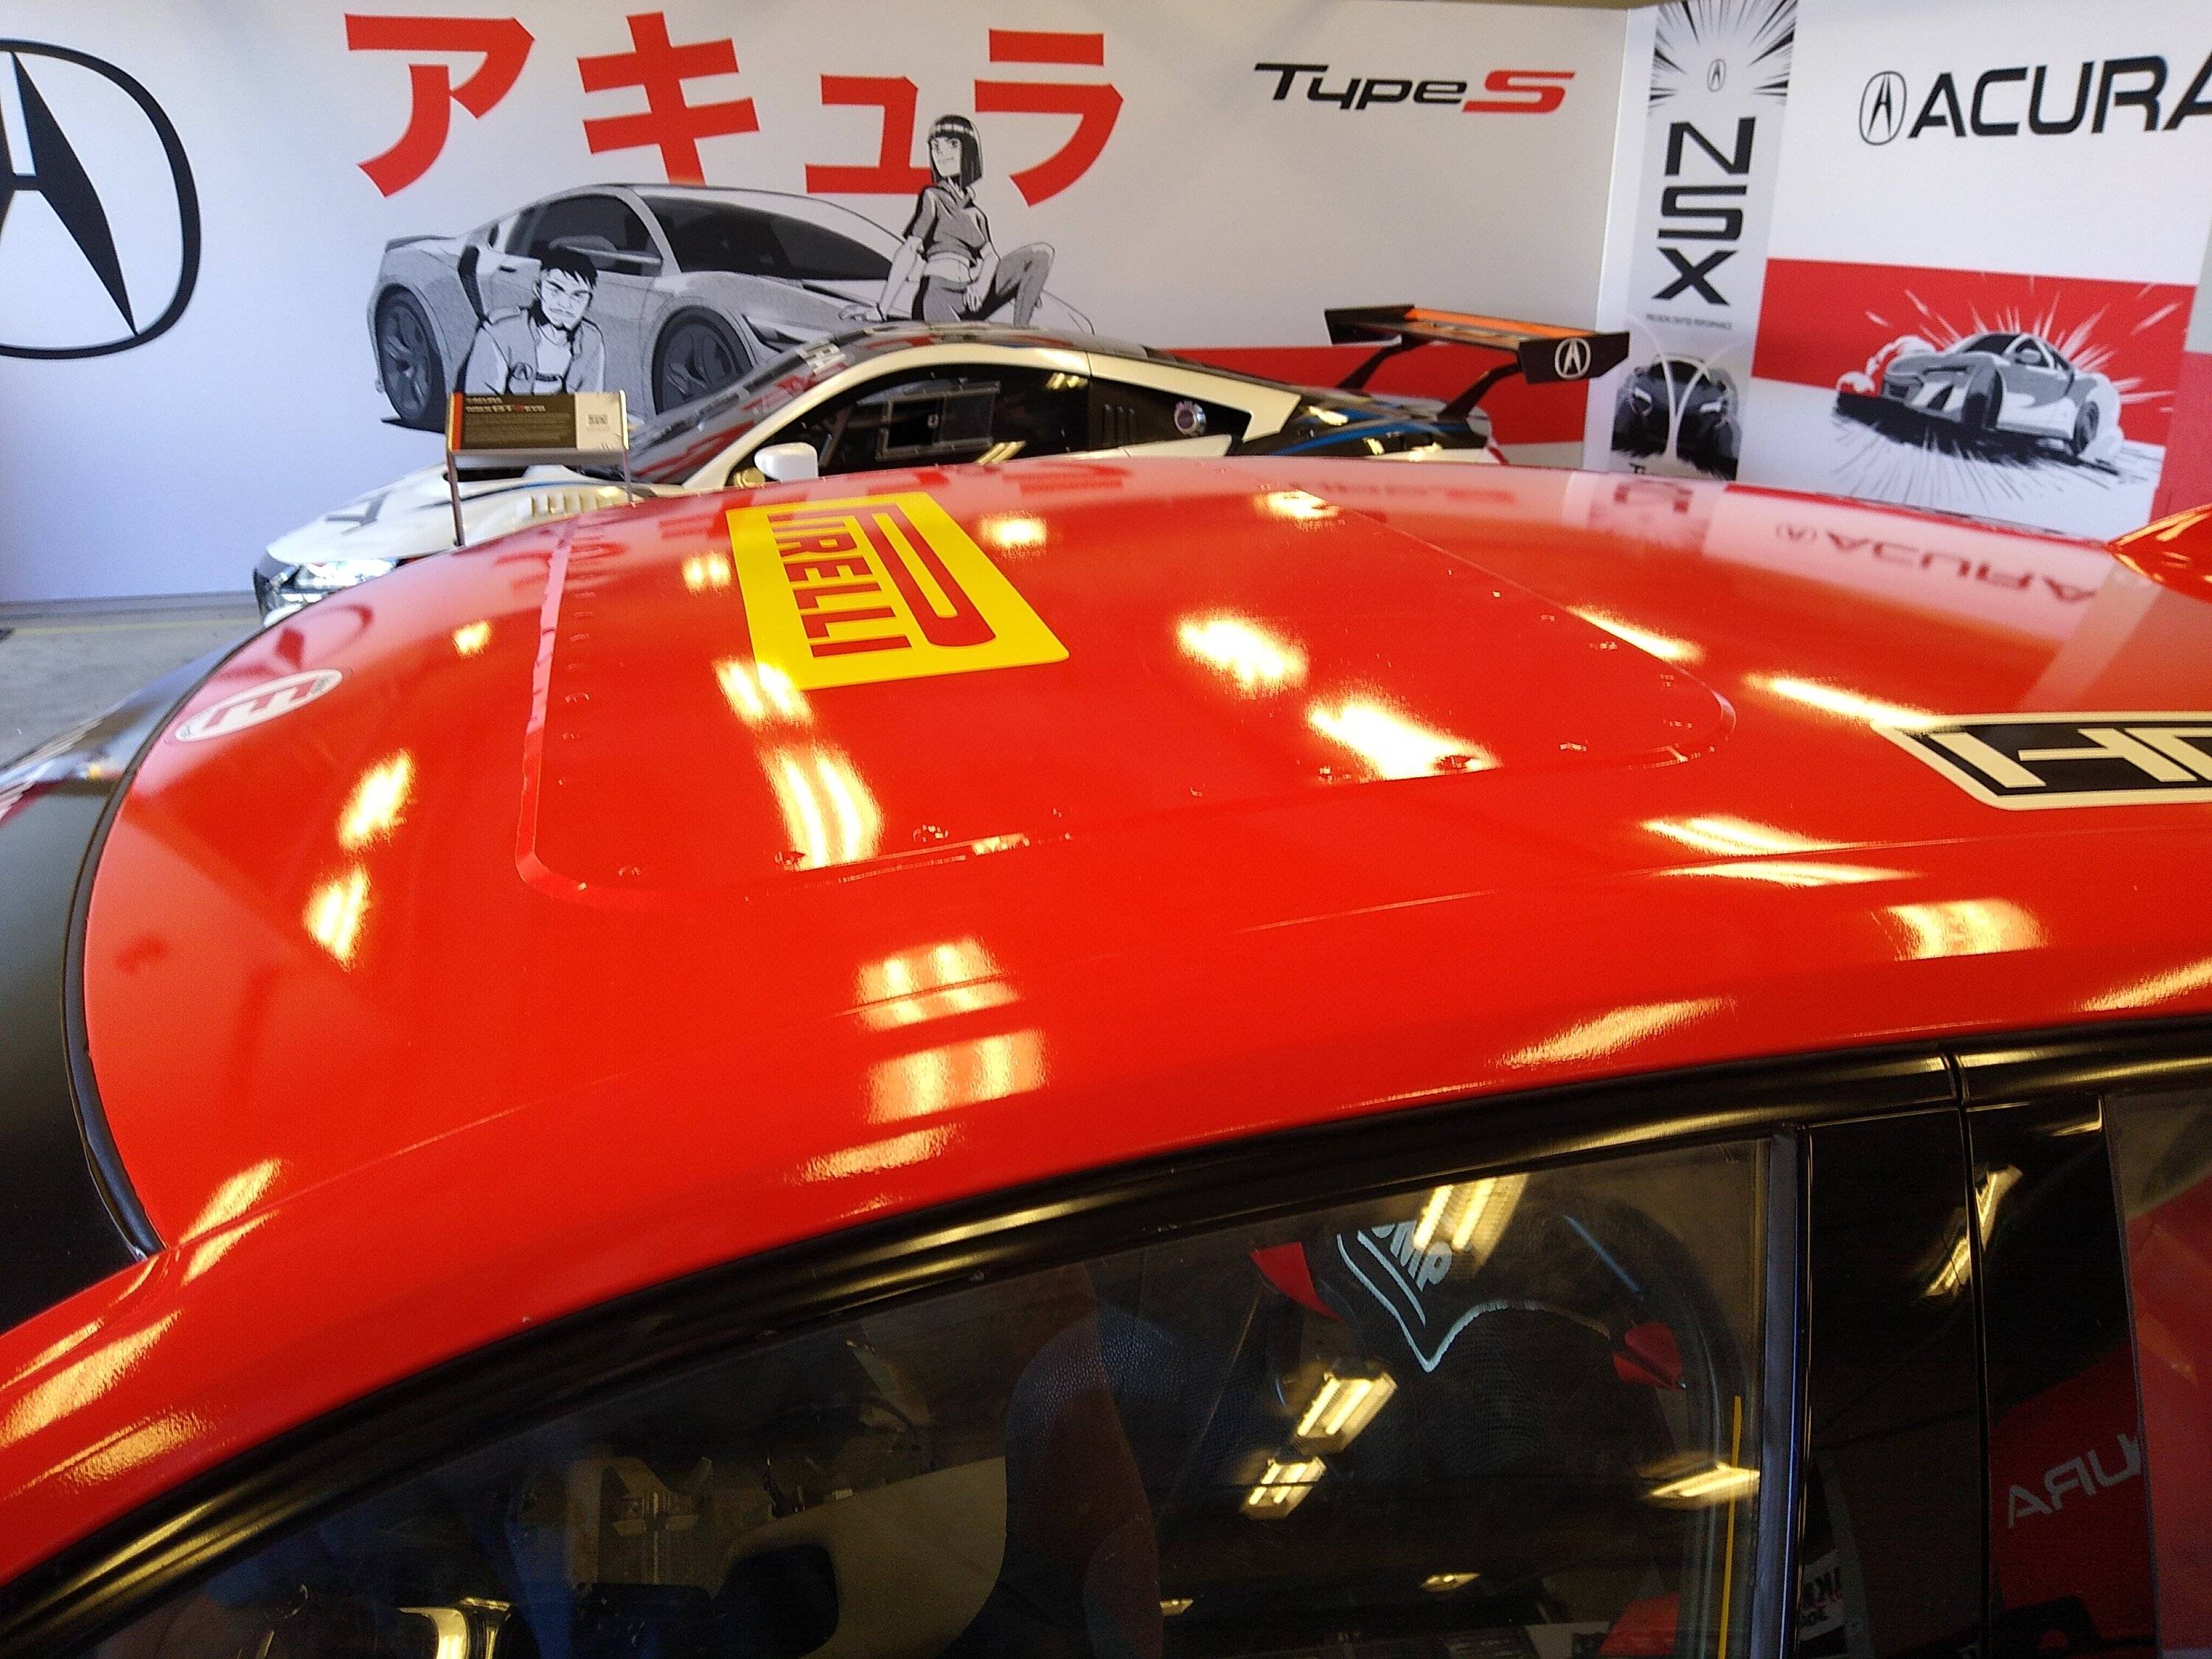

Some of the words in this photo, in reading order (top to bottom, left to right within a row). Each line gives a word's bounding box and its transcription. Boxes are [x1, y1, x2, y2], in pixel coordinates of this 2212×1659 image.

[345, 10, 1123, 206] アキュラ
[1652, 116, 1756, 307] NSX
[768, 503, 997, 658] PIRELLI
